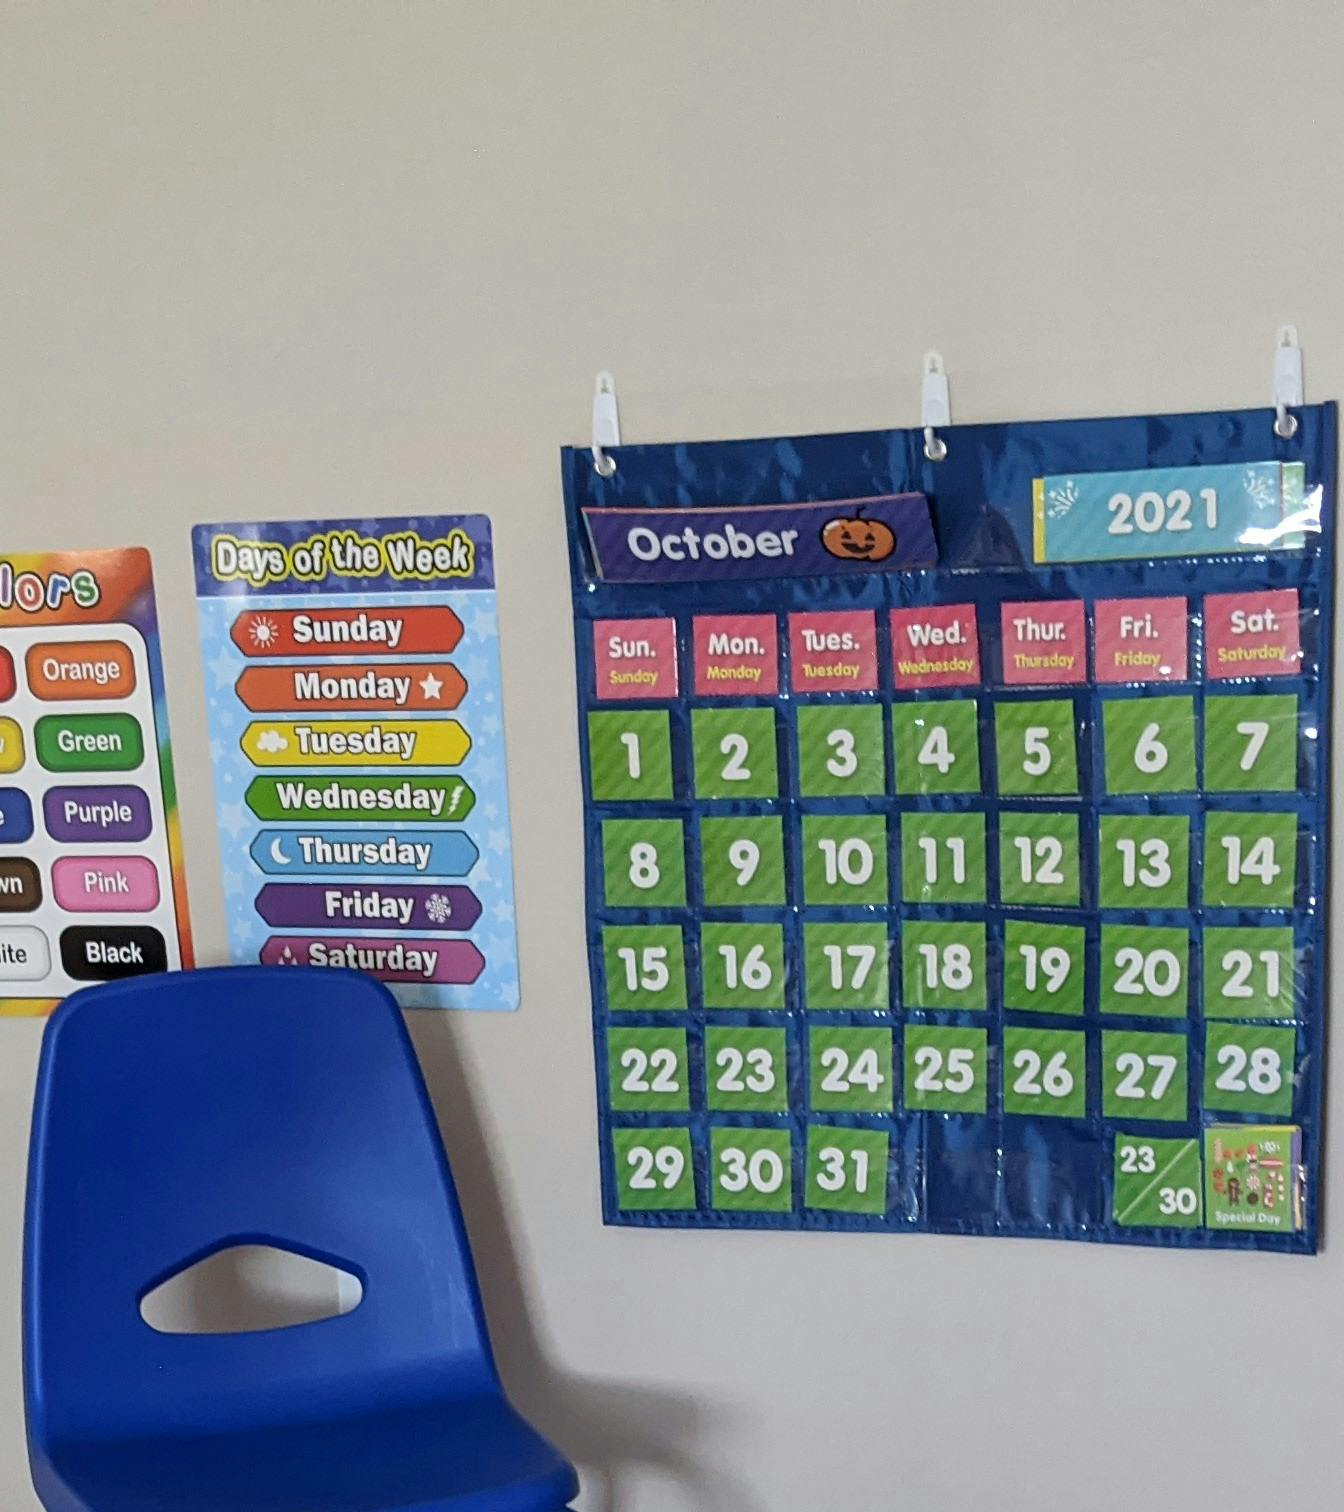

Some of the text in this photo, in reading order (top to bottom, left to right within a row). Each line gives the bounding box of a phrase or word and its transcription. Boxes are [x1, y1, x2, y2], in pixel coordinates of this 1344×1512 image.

[1107, 487, 1218, 534] 2021
[215, 534, 471, 583] Days of the Week
[627, 524, 798, 561] October
[293, 614, 403, 647] Sunday
[608, 610, 1279, 658] Sun. Mon. Tues. Wed. Thur. Fri. Sat.
[43, 659, 120, 683] Orange
[609, 646, 1285, 685] Sunday Monday Tuesday Wednesday Thursday Friday Saturday
[294, 671, 410, 705] Monday
[58, 731, 122, 752] Green
[295, 726, 416, 759] Tuesday
[621, 722, 1269, 780] 1 2 3 4 5 6 7
[65, 801, 132, 826] Purple
[276, 782, 445, 816] Wednesday
[299, 837, 431, 870] Thursday
[84, 871, 129, 893] Pink
[325, 891, 414, 923] Friday
[86, 942, 143, 964] Black
[309, 943, 438, 975] Saturday
[627, 1146, 868, 1193] 29 30 31
[1120, 1146, 1155, 1173] 23
[1159, 1188, 1197, 1215] 30
[1215, 1211, 1280, 1225] Special Day
